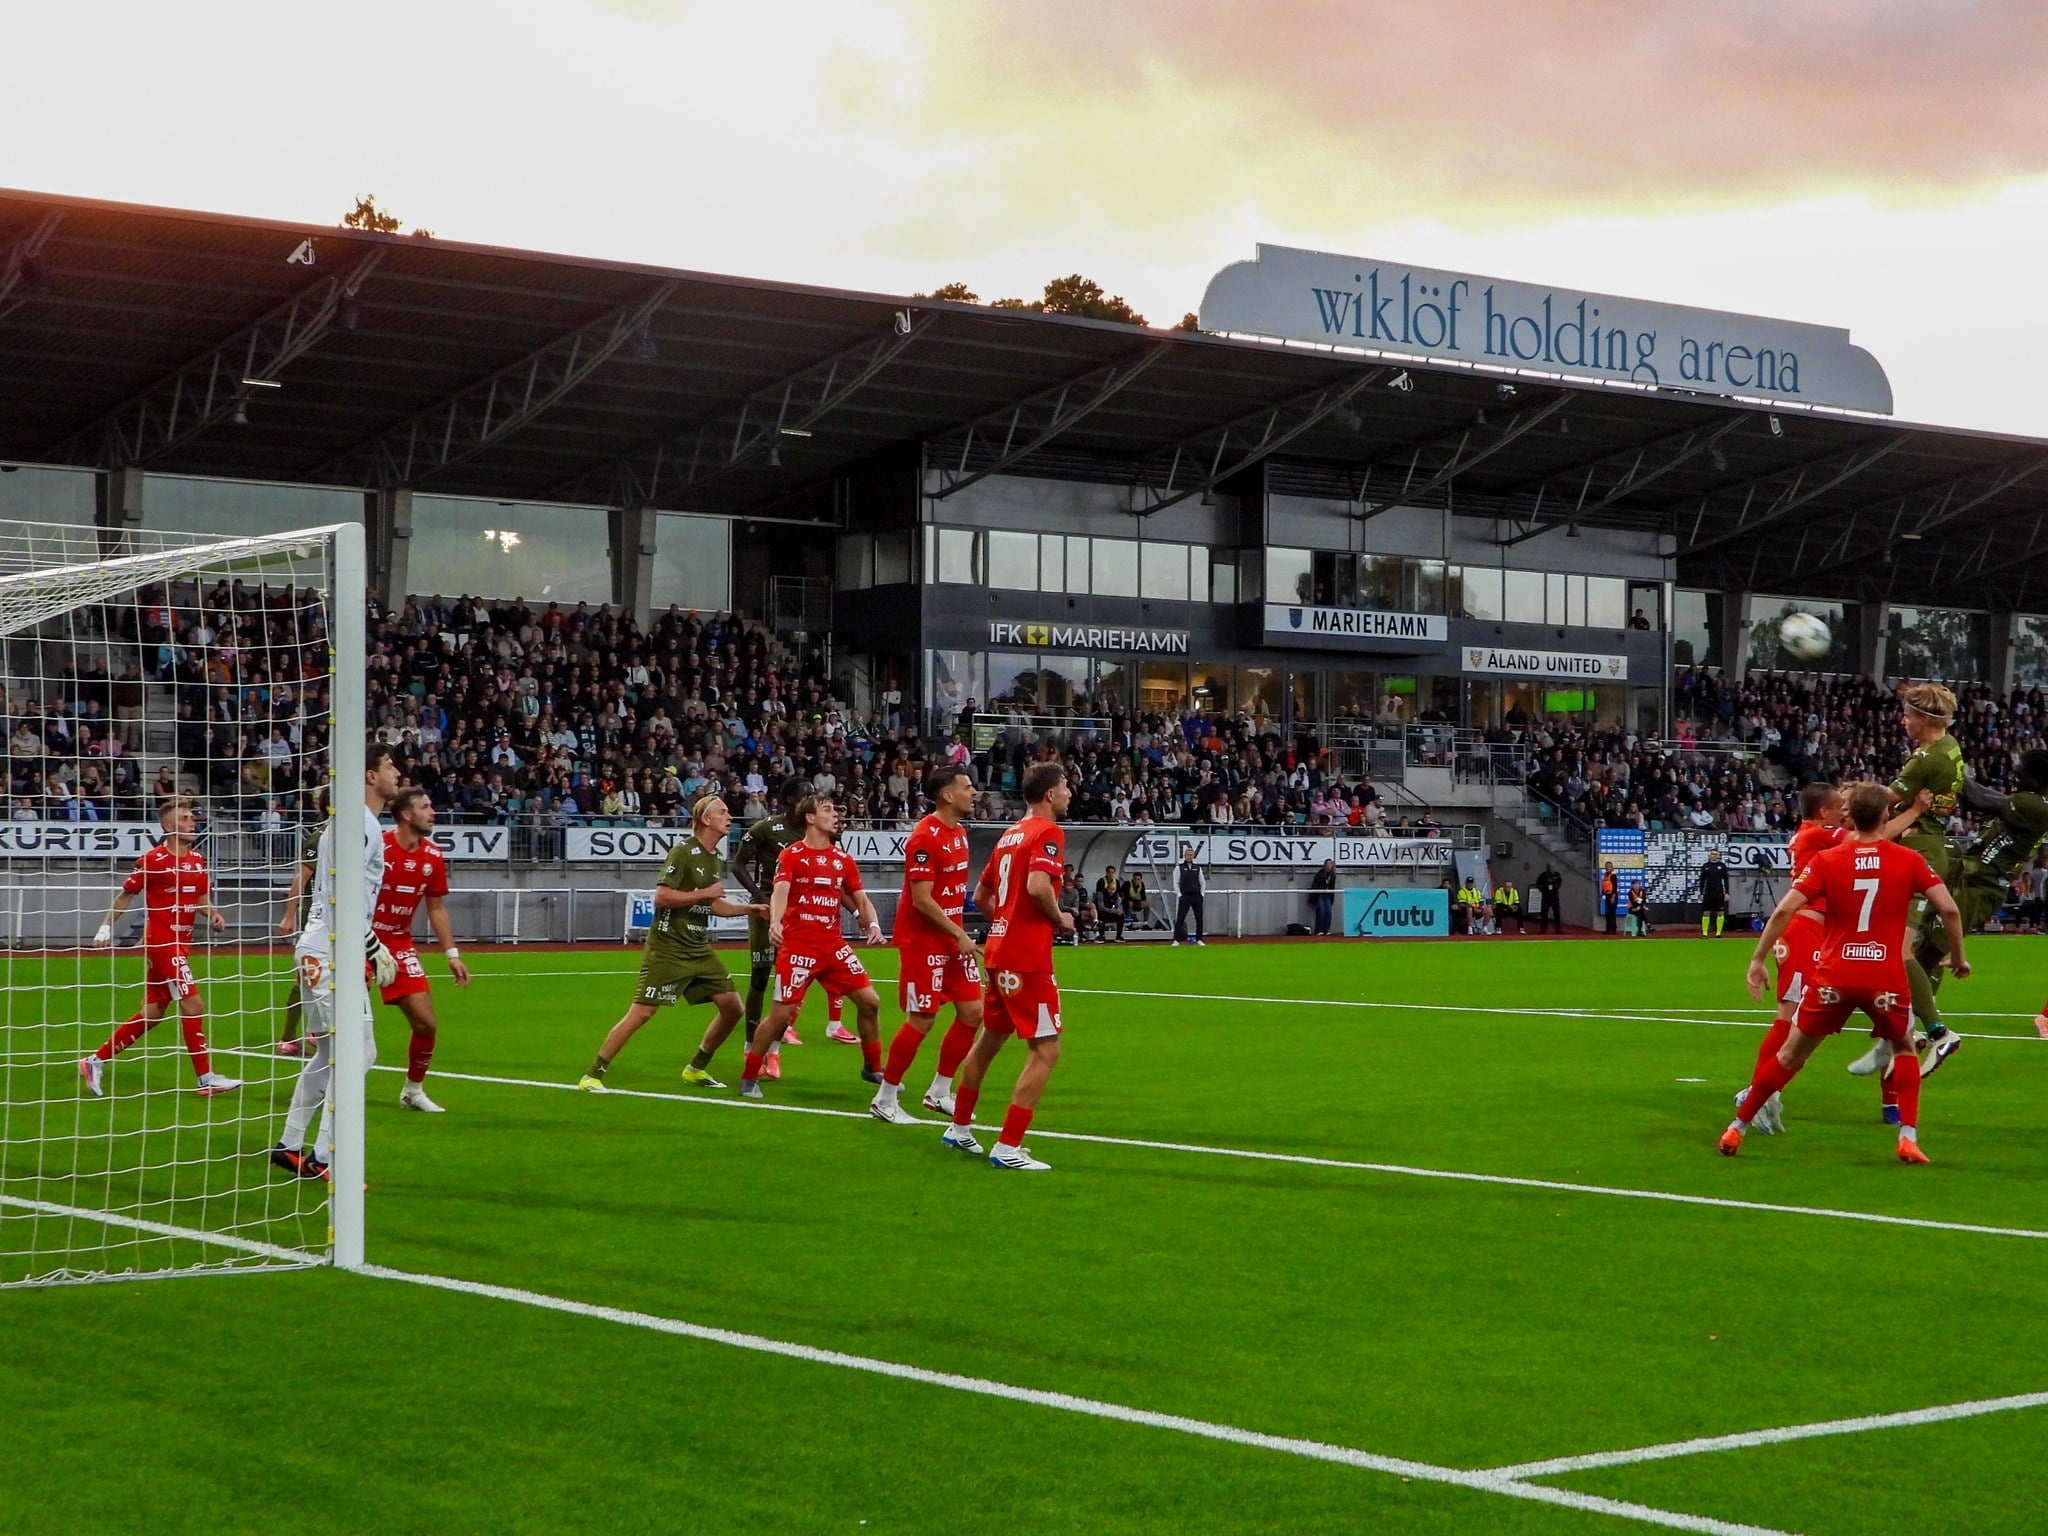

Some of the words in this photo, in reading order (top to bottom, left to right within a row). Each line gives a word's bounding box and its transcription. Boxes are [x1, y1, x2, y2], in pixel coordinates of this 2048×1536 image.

[1311, 268, 1468, 351] wiklöf
[1484, 286, 1660, 385] holding
[1679, 335, 1801, 393] arena
[1313, 610, 1428, 638] MARIEHAMN
[990, 623, 1022, 645] IFK
[1052, 626, 1187, 653] MARIEHAMN
[1487, 650, 1540, 670] ÅLAND
[1546, 656, 1602, 674] UNITED
[462, 831, 503, 853] TV
[590, 831, 692, 857] SON
[1228, 839, 1317, 861] SONY
[1339, 842, 1414, 861] BRAVIA
[1855, 856, 1880, 870] SKAU
[1373, 905, 1434, 927] ruutu
[1853, 878, 1880, 933] 7
[790, 954, 816, 967] OSTP
[1845, 945, 1883, 960] Hilltip
[645, 986, 657, 999] 27
[783, 985, 792, 999] 16
[918, 994, 932, 1008] 25
[1054, 1013, 1062, 1029] 8
